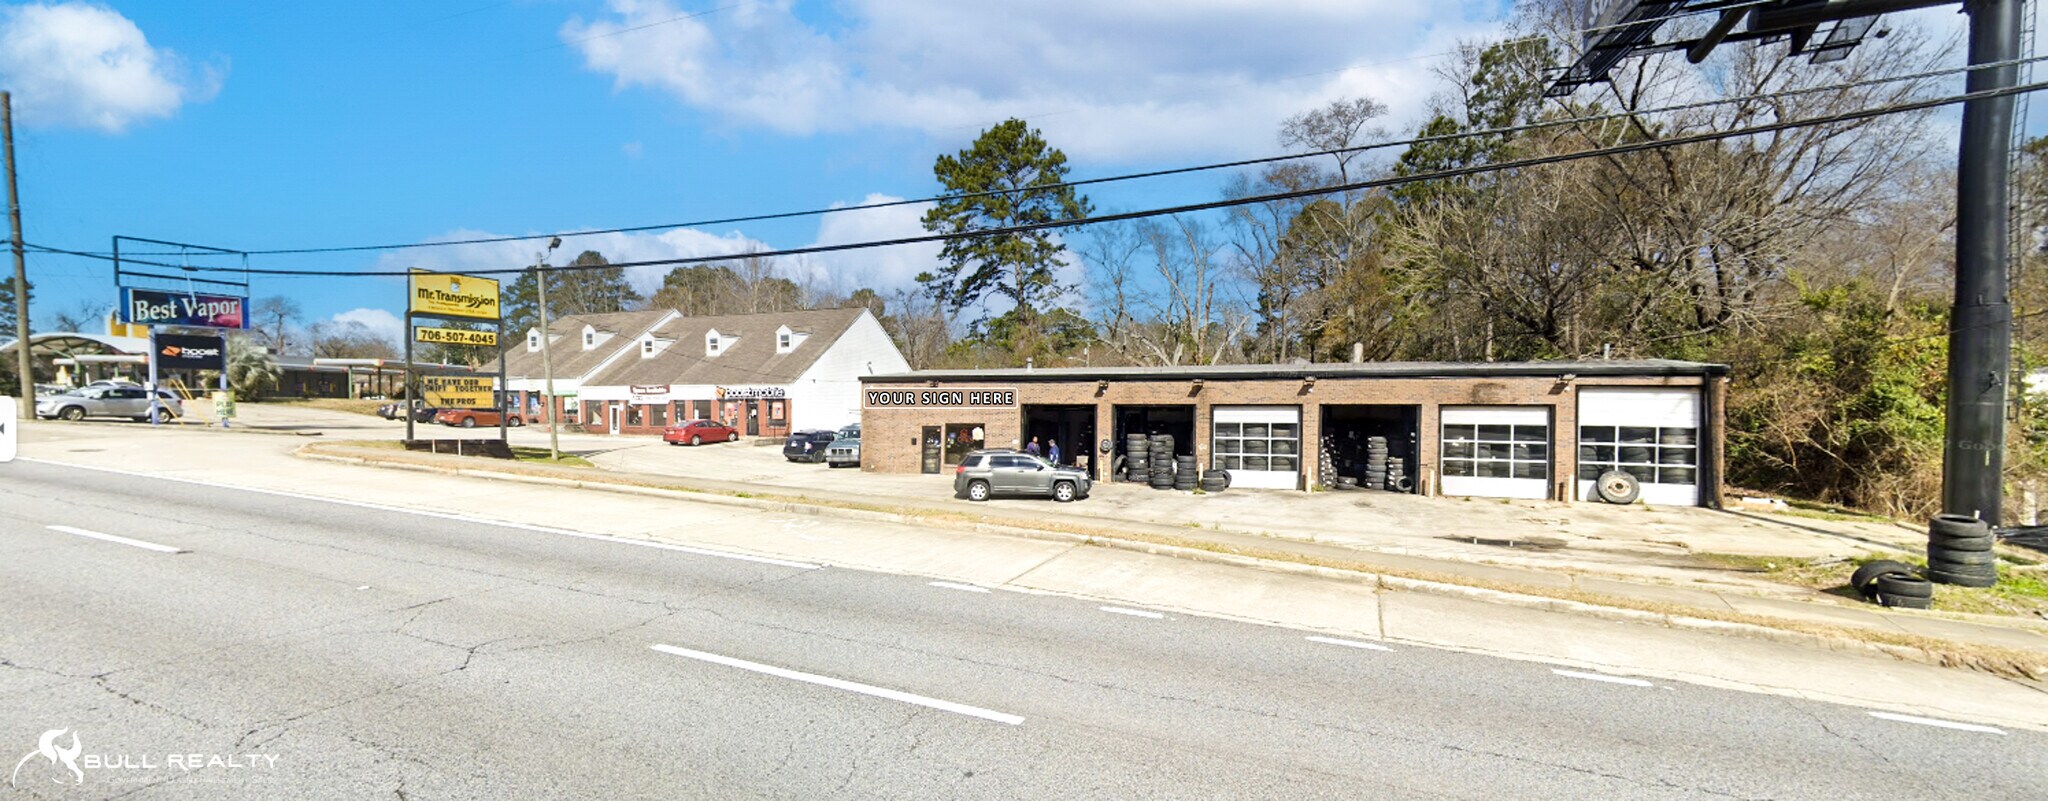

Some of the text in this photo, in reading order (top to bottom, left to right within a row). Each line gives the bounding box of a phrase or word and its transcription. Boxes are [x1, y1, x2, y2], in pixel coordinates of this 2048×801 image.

[418, 288, 495, 308] Mr. Transmission
[135, 298, 237, 322] Best Vapor
[421, 329, 494, 344] 706-507-4045
[181, 347, 219, 356] boost
[455, 385, 492, 393] TOGETHER
[440, 397, 455, 405] THE
